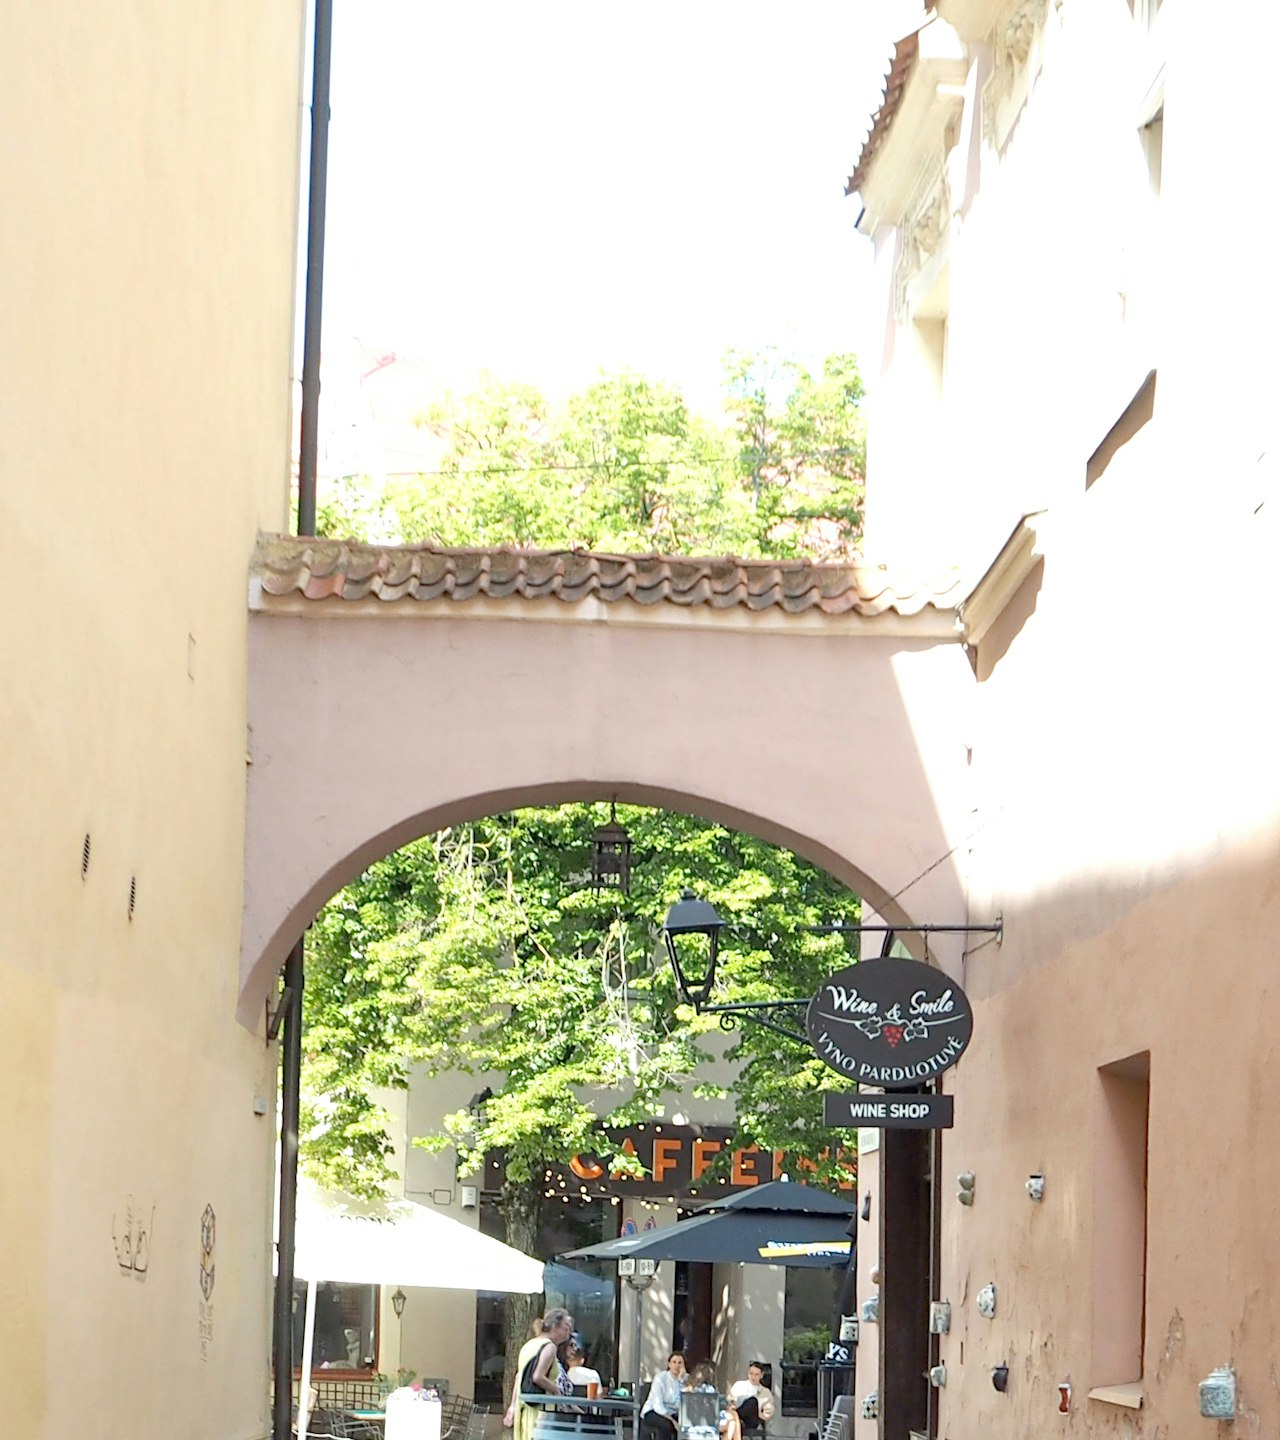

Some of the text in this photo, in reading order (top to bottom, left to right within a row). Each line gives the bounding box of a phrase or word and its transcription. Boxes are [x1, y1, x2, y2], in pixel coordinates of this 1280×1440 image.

[826, 985, 954, 1020] Wine & Smile
[818, 1032, 963, 1081] VYNO PARDUOTUVĖ
[850, 1103, 930, 1119] WINE SHOP
